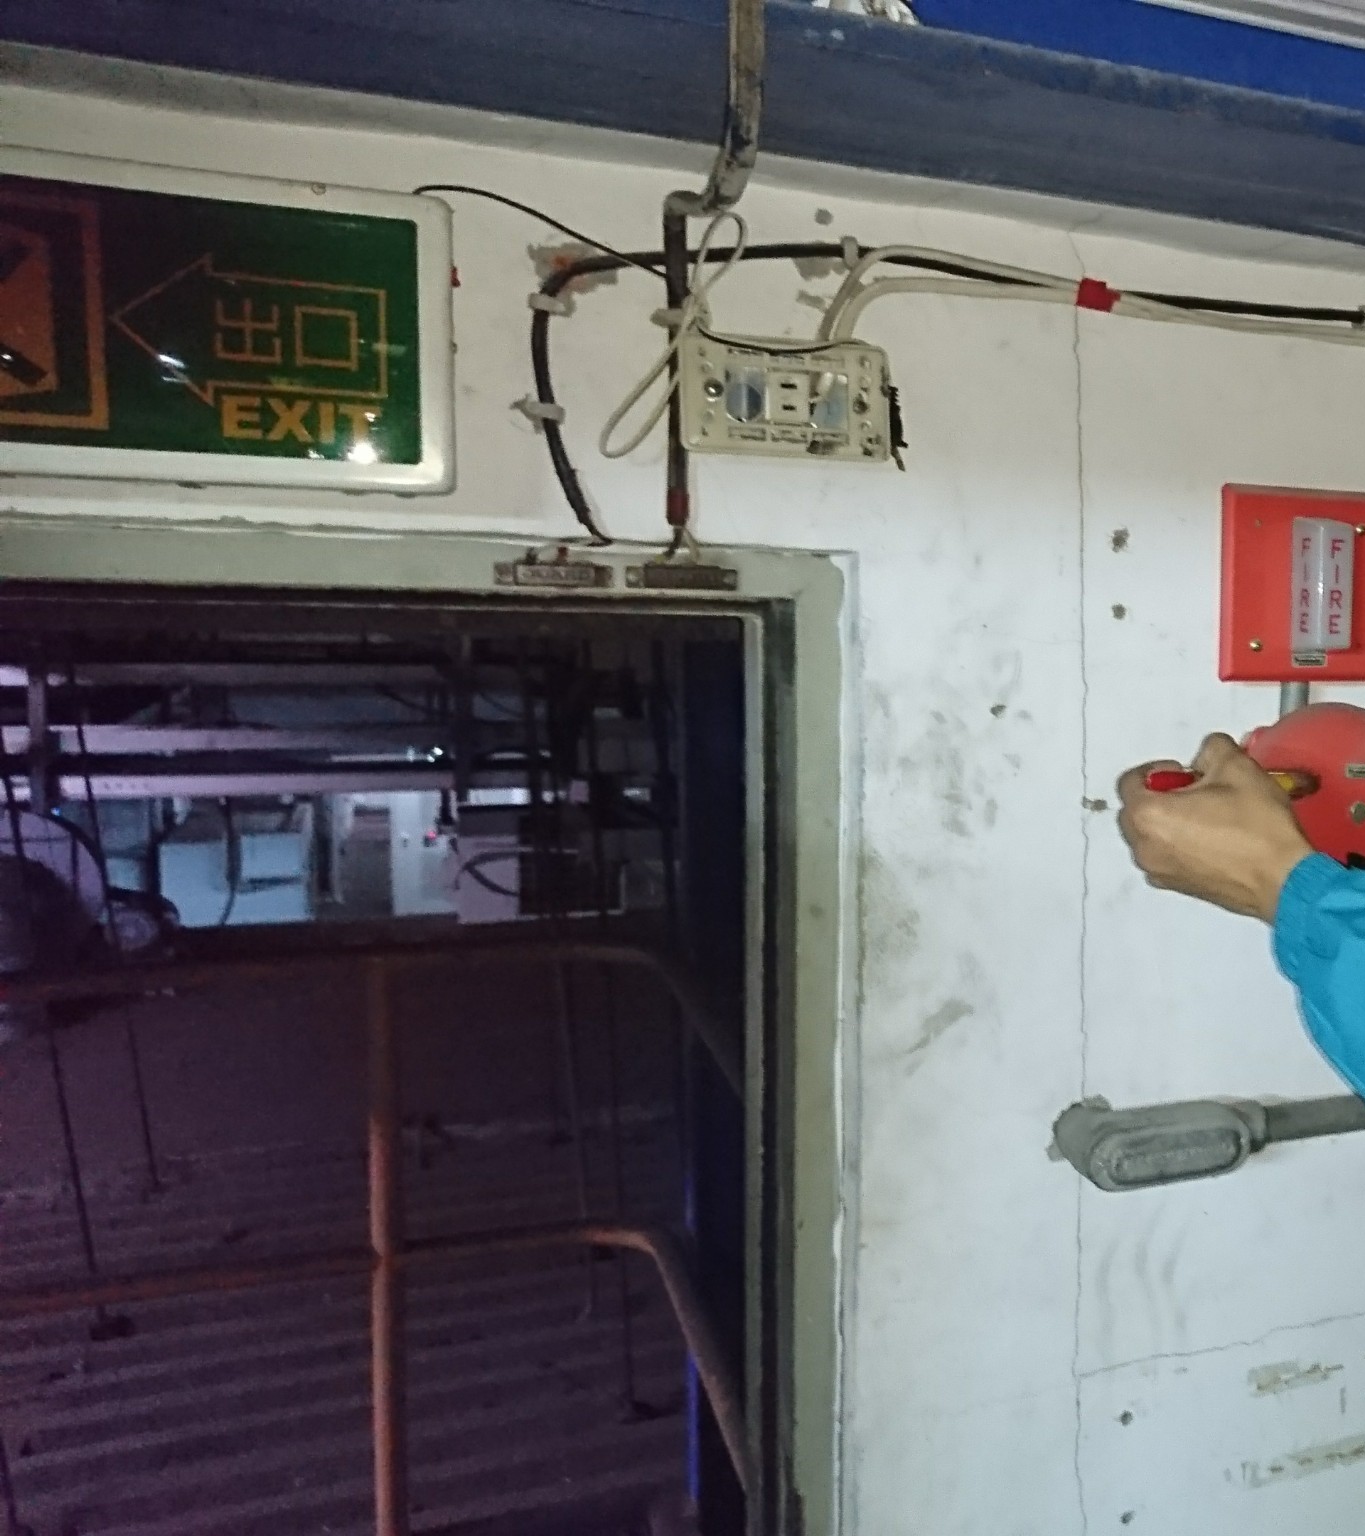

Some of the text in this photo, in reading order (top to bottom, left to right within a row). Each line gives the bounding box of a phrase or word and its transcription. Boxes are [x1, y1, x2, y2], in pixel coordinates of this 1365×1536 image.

[216, 298, 358, 371] 出口
[221, 394, 382, 446] EXIT
[1300, 537, 1311, 633] FIRE
[1328, 538, 1345, 635] FIRE
